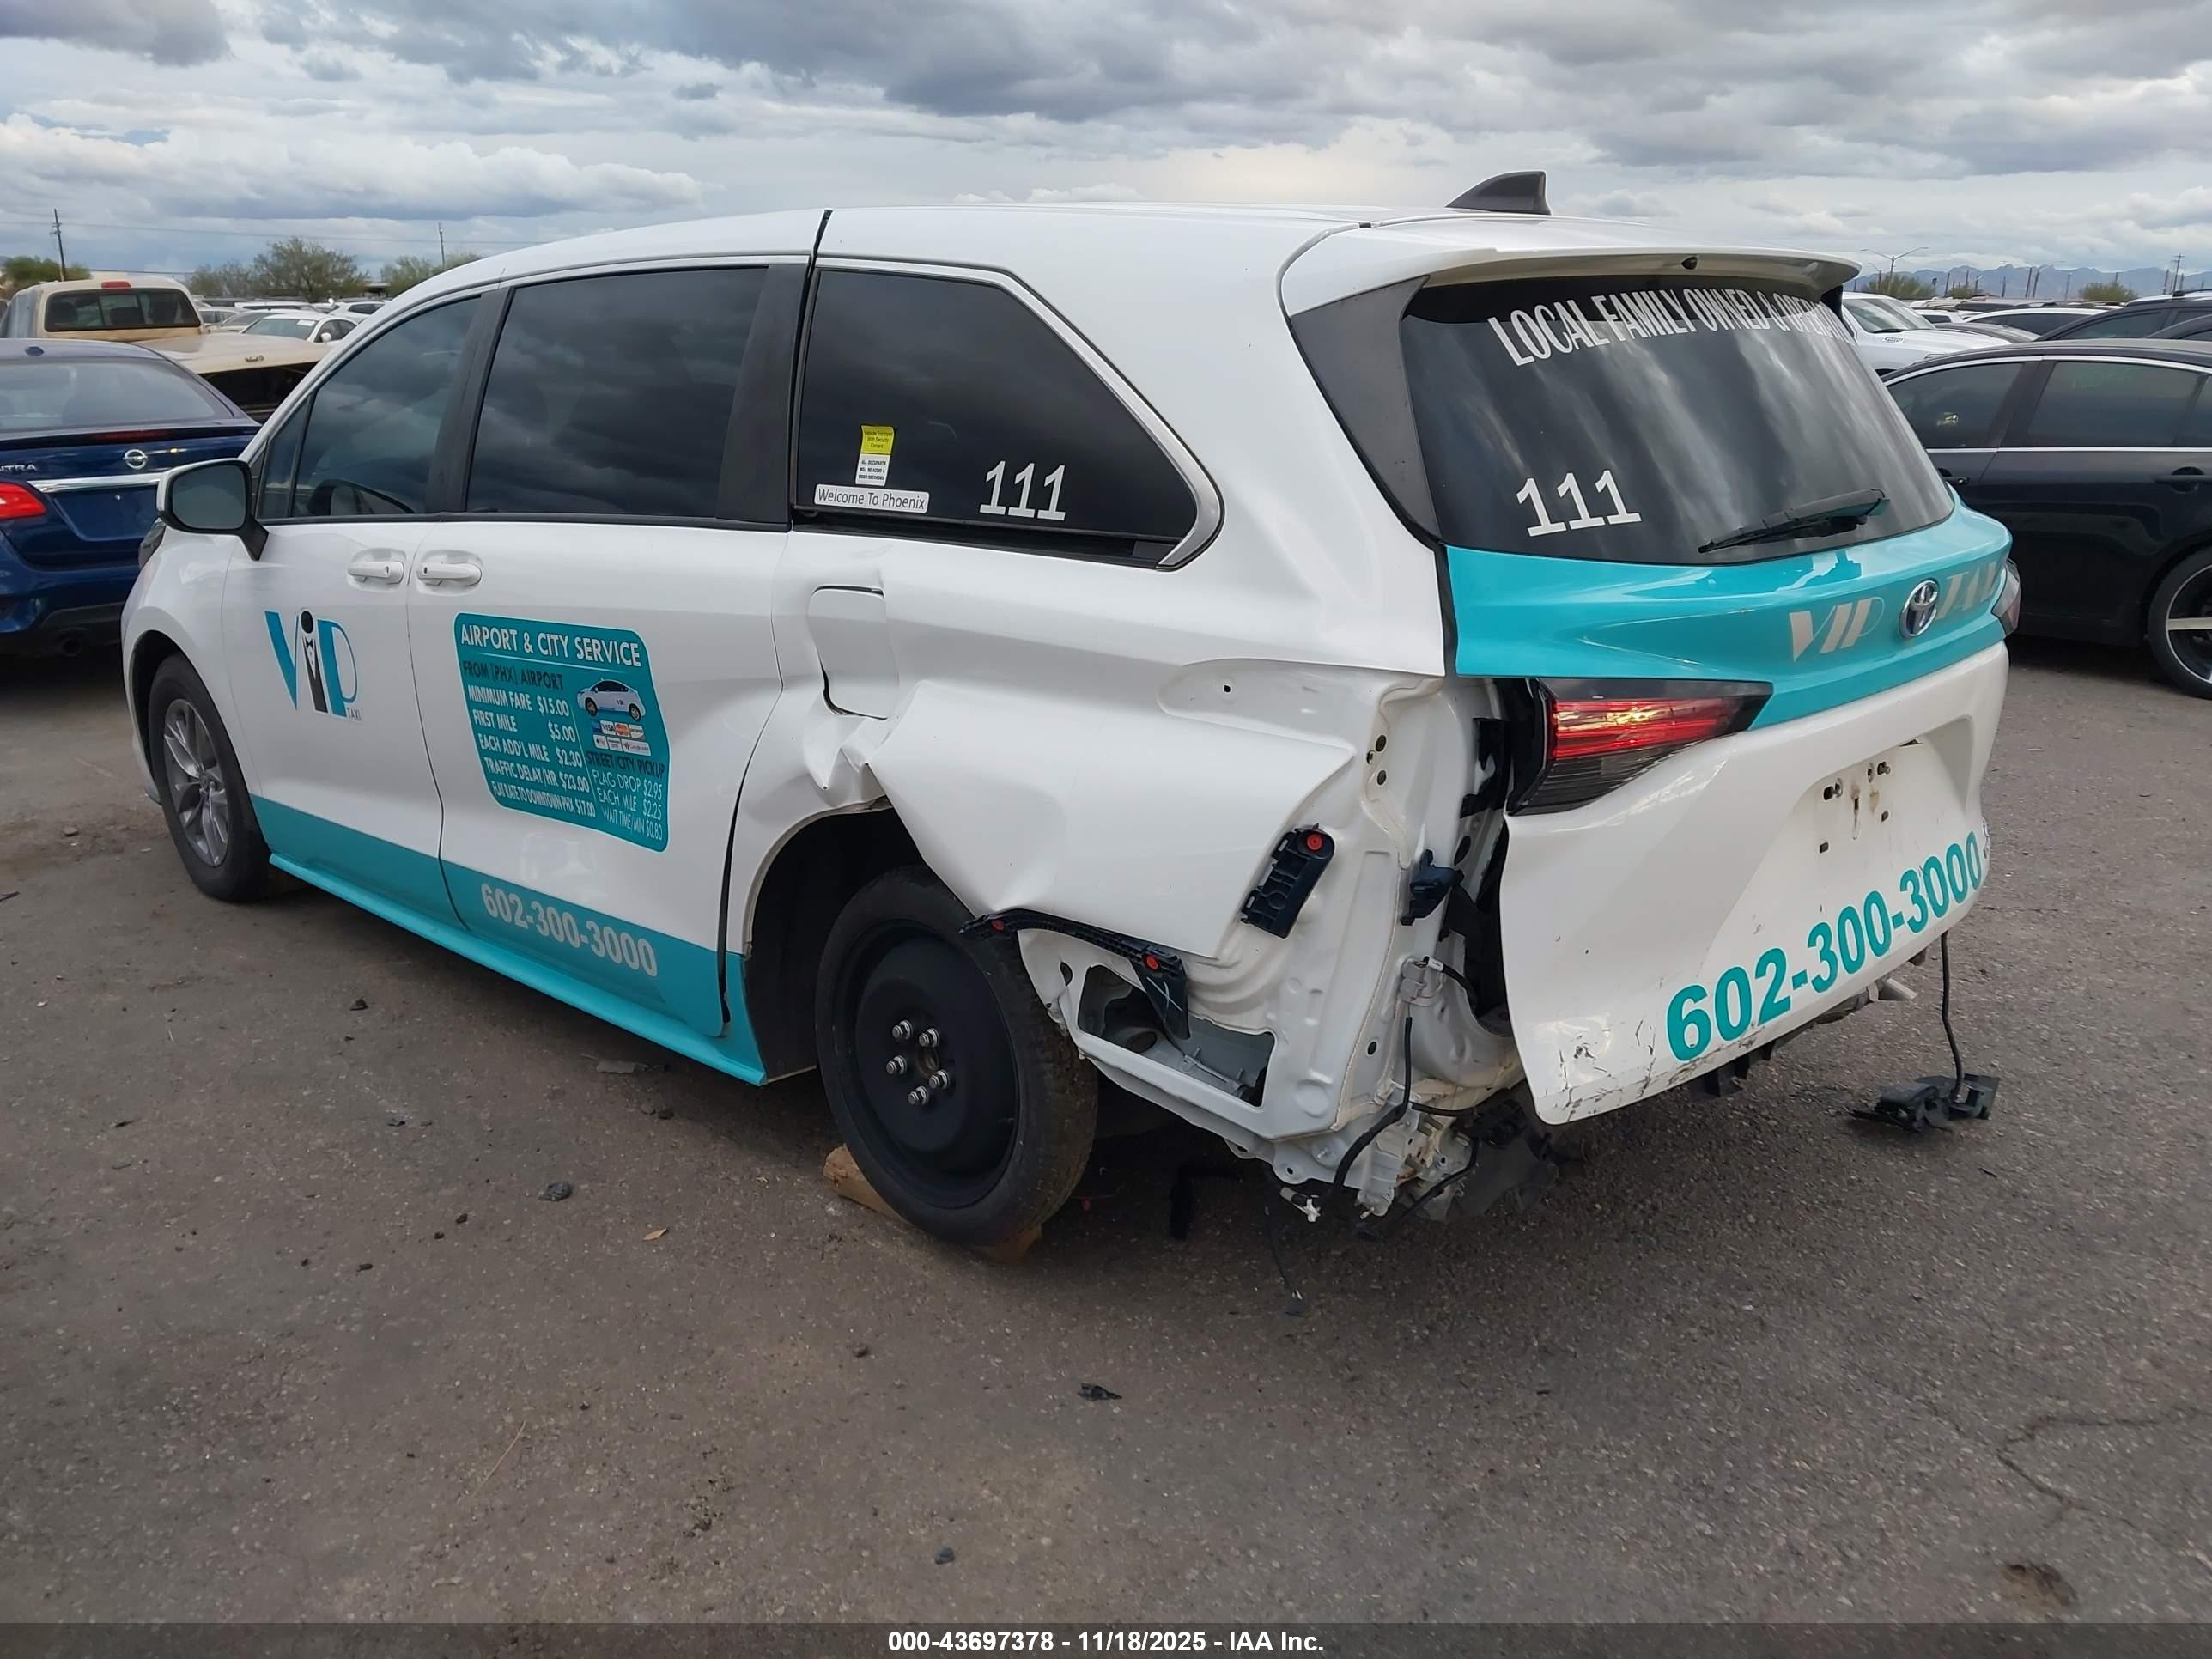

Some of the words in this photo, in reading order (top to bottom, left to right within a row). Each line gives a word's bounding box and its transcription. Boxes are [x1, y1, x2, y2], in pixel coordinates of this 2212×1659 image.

[1487, 298, 1611, 367] LOCAL
[1590, 289, 1696, 343] FAMILY
[1683, 288, 1771, 332] OWNED
[1757, 290, 1791, 331] &
[817, 488, 866, 505] Welcome
[868, 492, 879, 507] To
[881, 493, 926, 511] Phoenix
[979, 460, 1066, 520] 111
[1516, 470, 1642, 537] 111
[461, 624, 517, 651] AIRPORT
[524, 632, 533, 653] &
[538, 633, 568, 658] CITY
[574, 637, 641, 667] SERVICE
[1789, 596, 1886, 663] VIP
[464, 661, 488, 678] FROM
[521, 671, 563, 690] AIRPORT
[468, 685, 508, 707] MINIMUM
[508, 692, 532, 711] FARE
[537, 694, 569, 717] $15.00
[473, 709, 495, 728] FIRST
[496, 714, 518, 732] MILE
[548, 721, 575, 743] $5.00
[478, 733, 500, 752] EACH
[503, 739, 528, 757] ADD'L
[529, 743, 550, 762] MILE
[556, 746, 582, 768] $2.30
[484, 757, 517, 778] TRAFFIC
[559, 771, 590, 793] $23.00
[592, 769, 617, 788] FLAG
[617, 774, 641, 793] DROP
[643, 779, 663, 801] $2.95
[637, 760, 665, 779] PICKUP
[526, 787, 562, 811] DOWNTOWN
[597, 787, 619, 805] EACH
[622, 793, 637, 812] MILE
[642, 799, 662, 821] $2.25
[602, 808, 618, 825] WAIT
[646, 820, 663, 841] $0.80
[481, 883, 658, 977] 602-300-3000
[1666, 830, 1983, 1062] 602-300-3000
